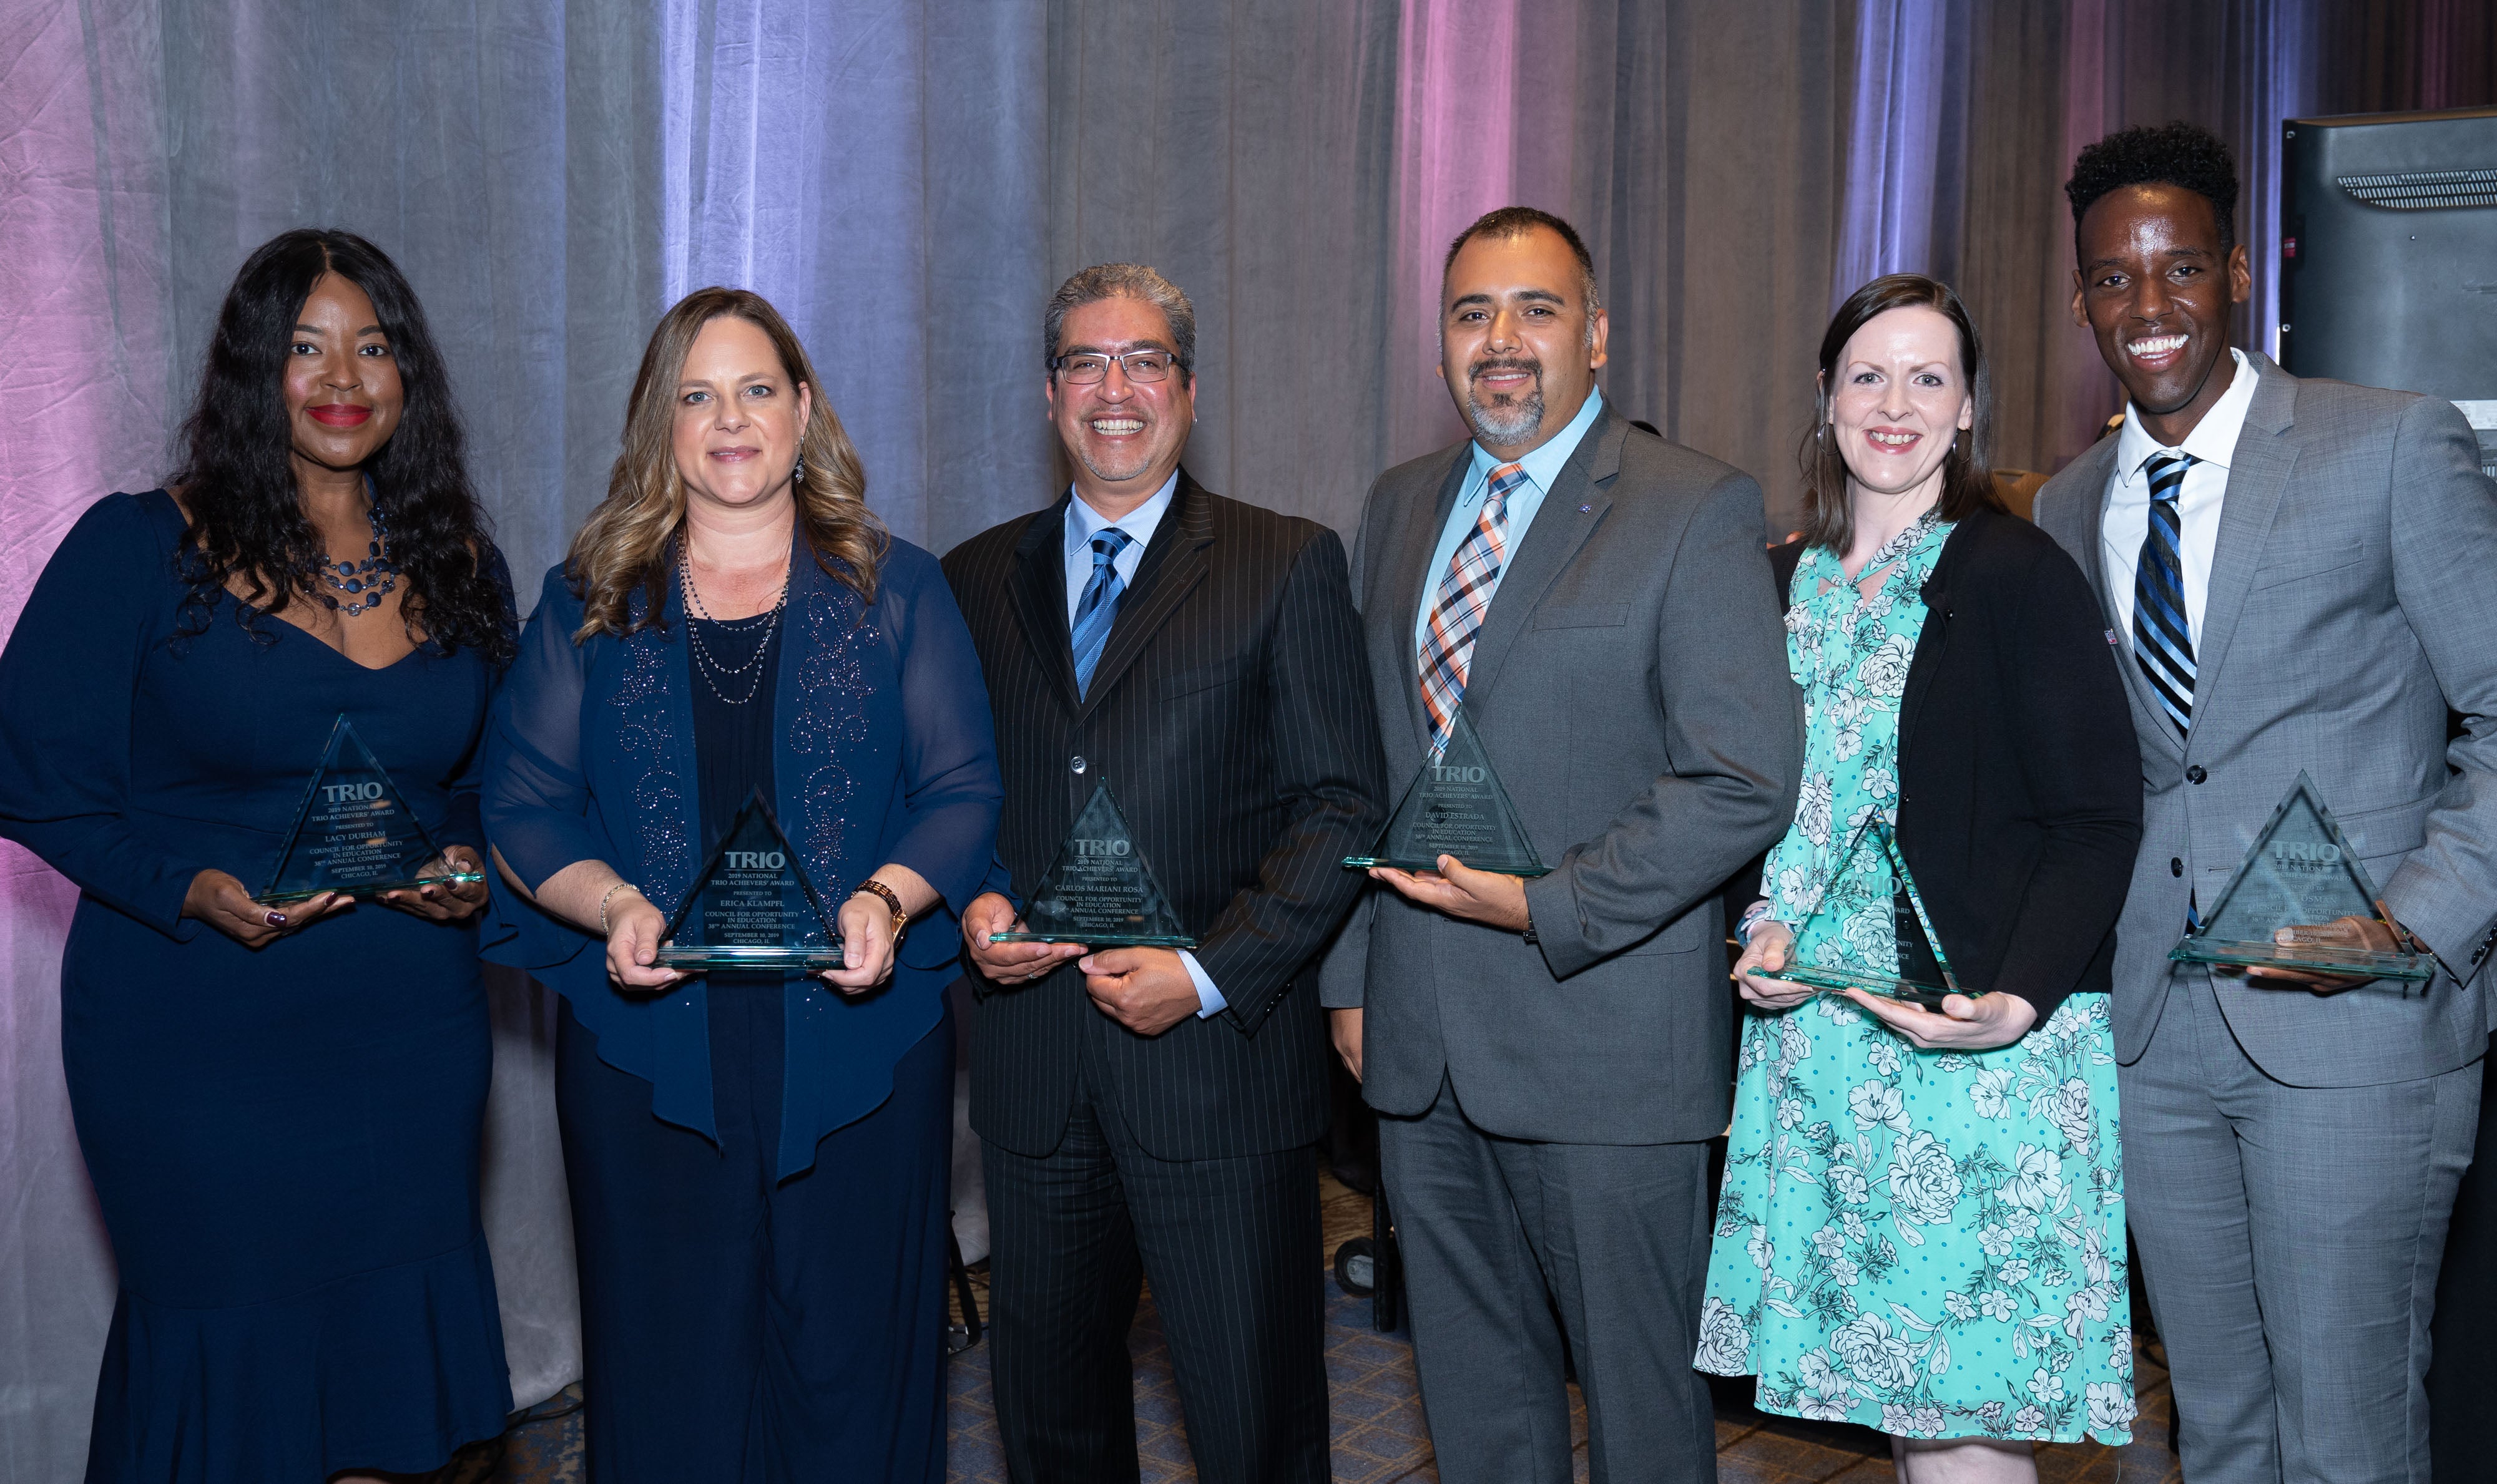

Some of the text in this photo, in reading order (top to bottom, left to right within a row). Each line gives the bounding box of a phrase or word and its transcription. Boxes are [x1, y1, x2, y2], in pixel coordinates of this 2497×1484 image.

[1431, 766, 1485, 783] TRIO
[322, 782, 383, 803] TRIO
[348, 831, 386, 840] DURHAM
[310, 846, 340, 854] COUNCIL
[356, 841, 403, 849] OPPORTUNITY
[342, 849, 381, 857] EDUCATION
[1075, 839, 1130, 856] TRIO
[2270, 841, 2340, 862] TRIO
[358, 853, 401, 863] CONFERENCE
[725, 852, 785, 869] TRIO
[1845, 872, 1902, 894] TRIO
